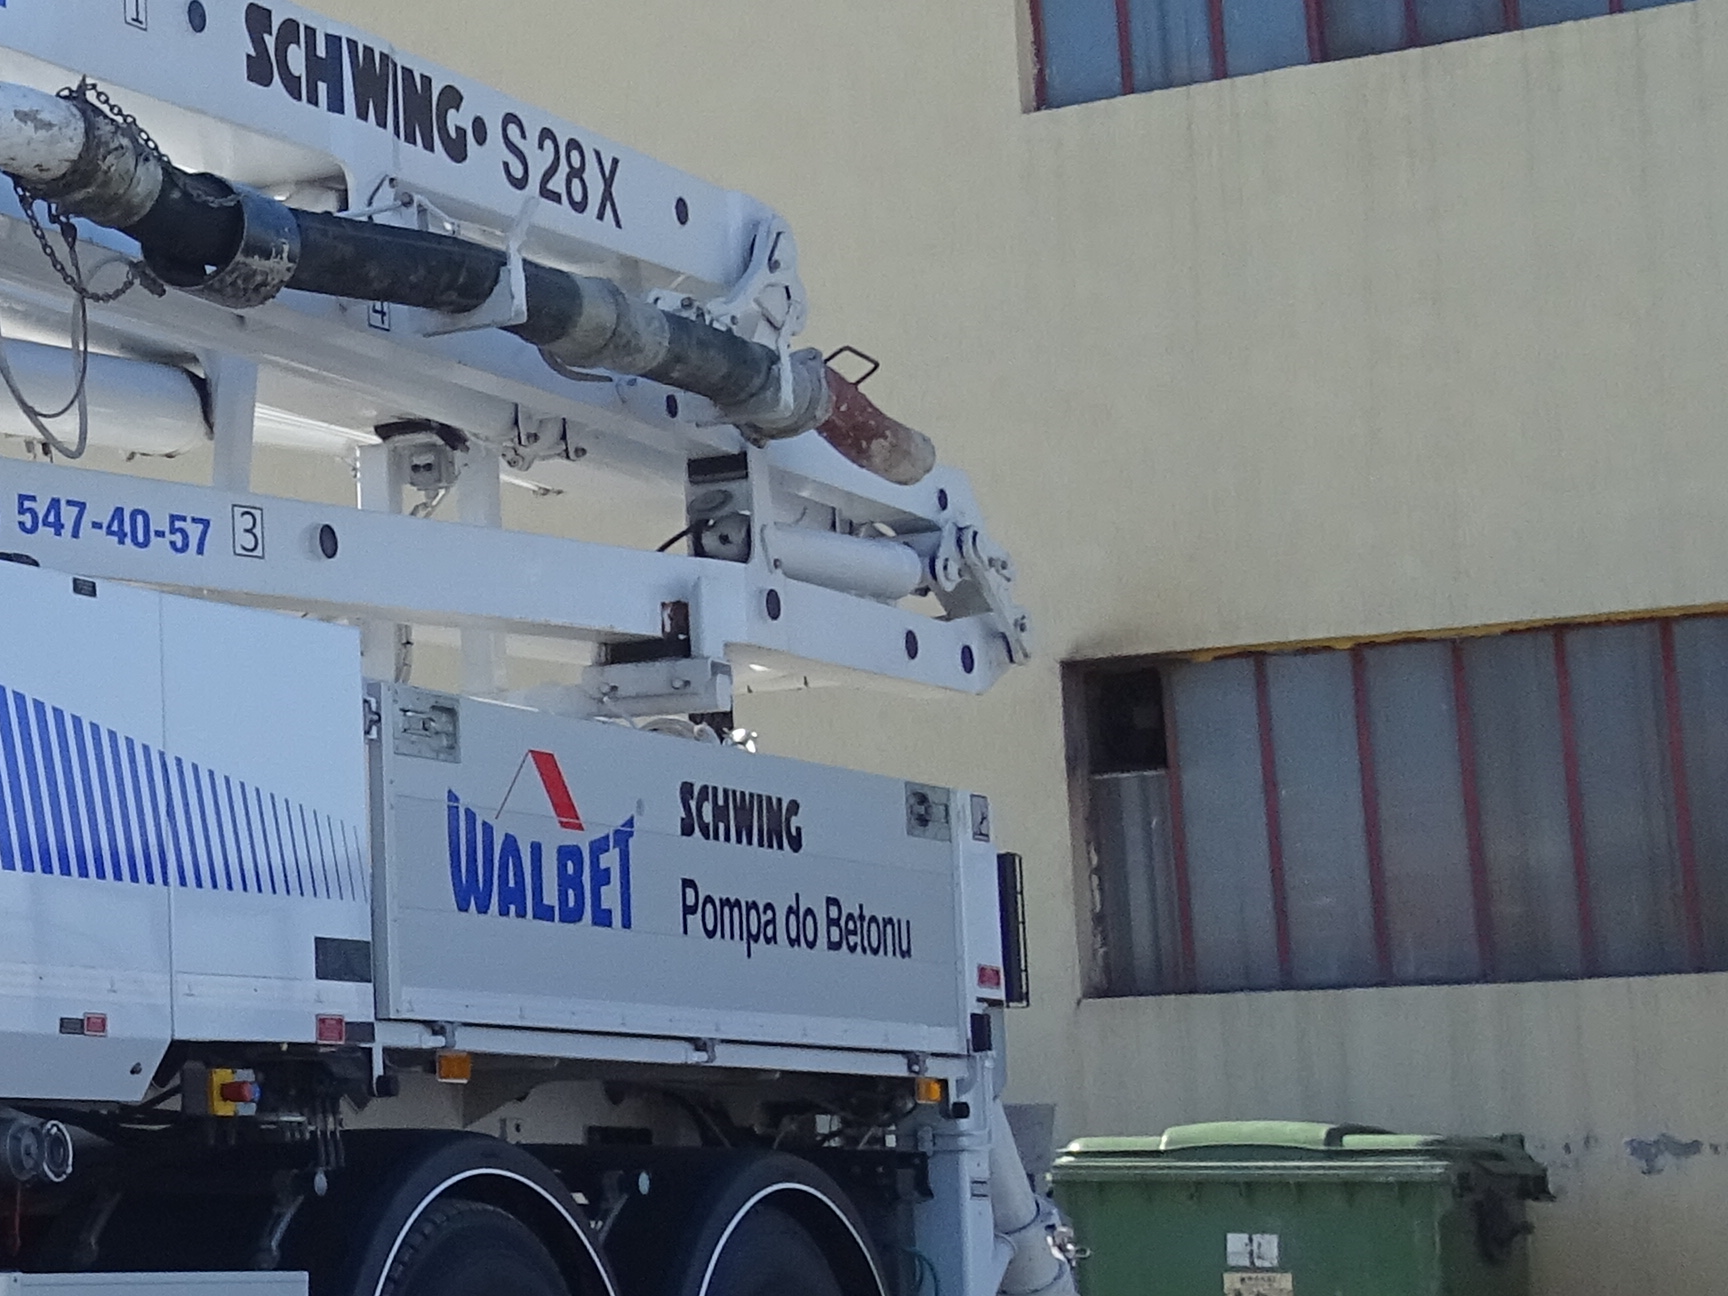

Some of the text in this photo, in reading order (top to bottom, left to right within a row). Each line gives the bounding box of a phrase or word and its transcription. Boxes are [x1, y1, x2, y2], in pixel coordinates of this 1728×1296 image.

[244, 2, 469, 164] SCHWING
[17, 493, 211, 556] 547-40-57
[240, 510, 259, 553] 3
[679, 780, 803, 854] SCHWING
[446, 788, 635, 931] WALBET
[680, 877, 912, 960] Pompa do Betonu
